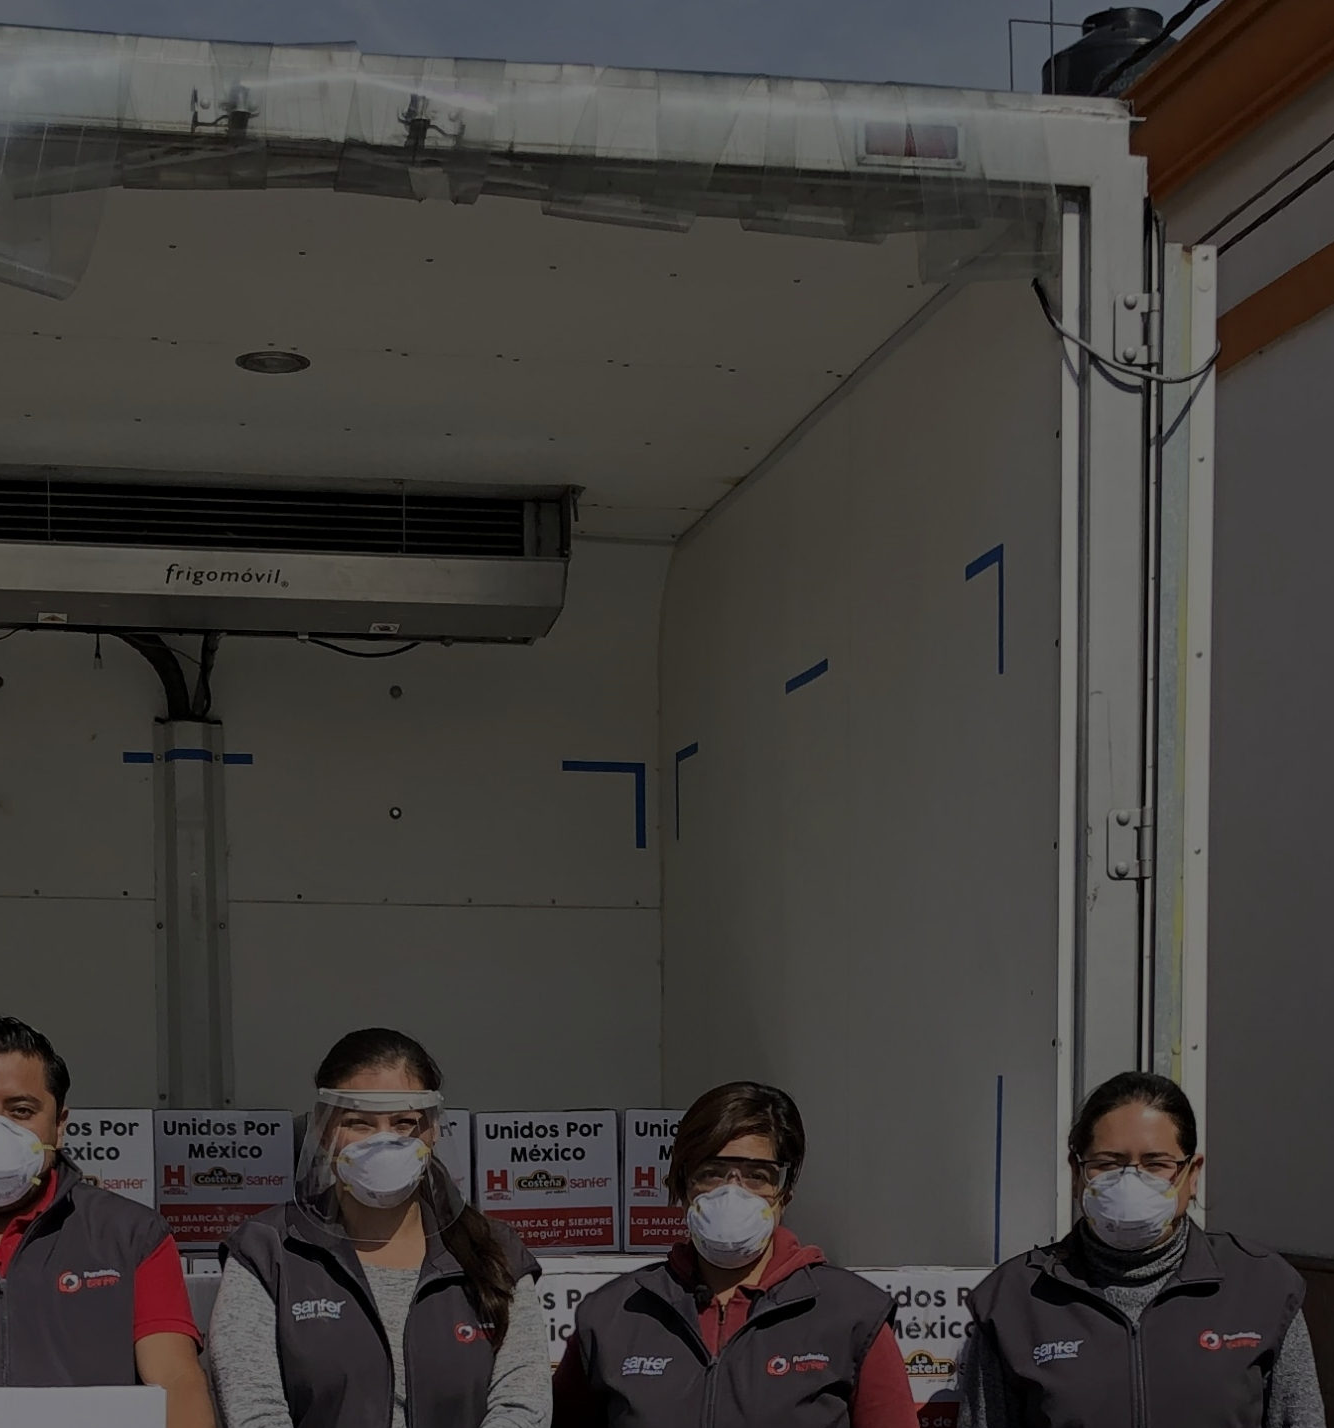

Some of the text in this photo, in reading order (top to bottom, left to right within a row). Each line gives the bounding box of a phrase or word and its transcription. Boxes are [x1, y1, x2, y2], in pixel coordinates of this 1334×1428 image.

[165, 563, 281, 586] frigomóvil
[100, 1120, 139, 1136] Por
[163, 1118, 281, 1136] Unidos Por
[485, 1120, 603, 1139] Unidos Por
[635, 1119, 680, 1137] Unid
[63, 1141, 120, 1161] éxico
[188, 1142, 263, 1159] México
[511, 1144, 585, 1162] México
[246, 1175, 285, 1186] sanfer
[536, 1170, 546, 1179] La
[103, 1178, 144, 1190] sanfer
[569, 1177, 608, 1189] sanfer
[182, 1214, 224, 1222] MARCAS
[227, 1214, 241, 1222] de
[551, 1218, 565, 1226] de
[568, 1217, 612, 1226] SIEMPRE
[630, 1217, 687, 1225] Las MARCA
[173, 1225, 200, 1235] para
[527, 1229, 562, 1240] seguir
[564, 1228, 603, 1239] JUNTOS
[642, 1228, 690, 1237] para seg
[886, 1284, 946, 1307] dos
[291, 1298, 346, 1316] sanfer
[1033, 1339, 1084, 1359] sanfer
[622, 1356, 673, 1370] sanfer
[915, 1356, 928, 1364] La
[906, 1362, 948, 1374] osteña
[933, 1416, 952, 1427] de
